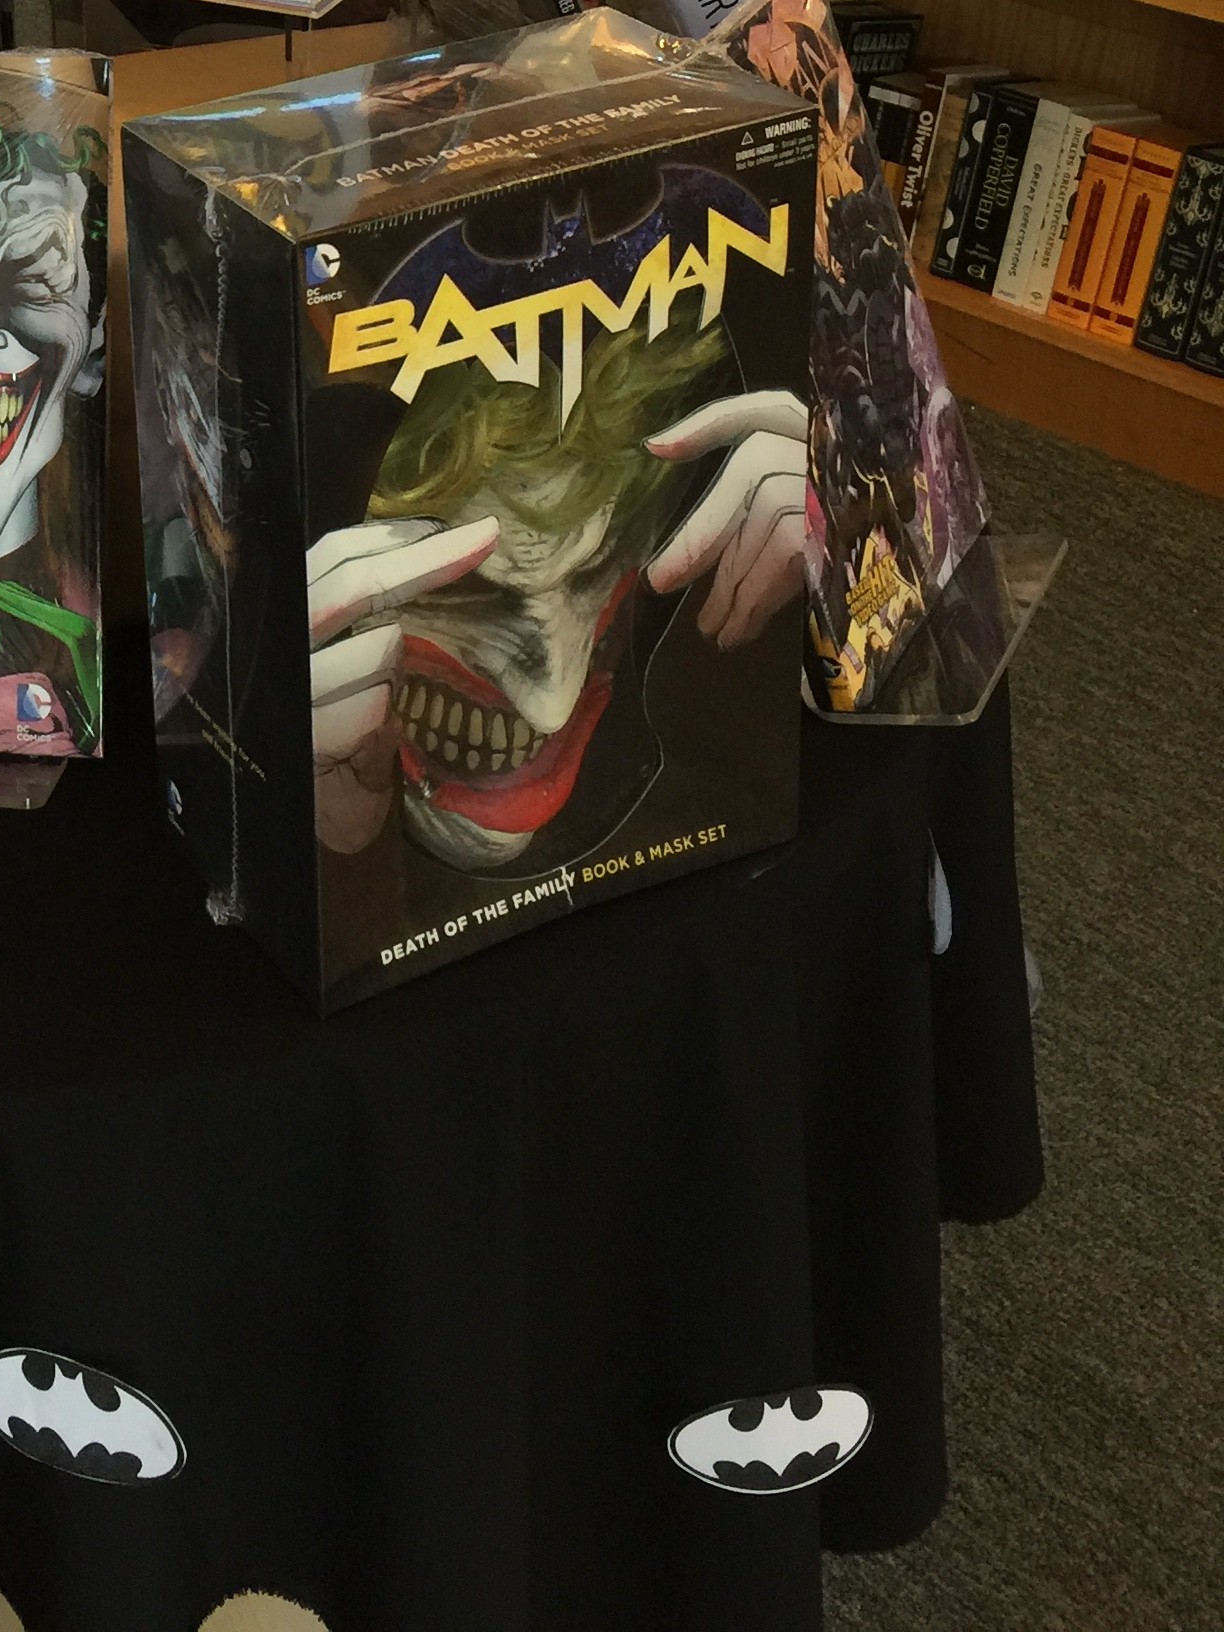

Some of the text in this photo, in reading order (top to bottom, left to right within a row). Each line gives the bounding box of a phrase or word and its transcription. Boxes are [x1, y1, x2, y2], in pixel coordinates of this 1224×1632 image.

[852, 32, 911, 51] CHARLES
[335, 151, 435, 189] BATMAN
[437, 129, 516, 163] DEATH
[519, 123, 558, 144] OF
[557, 110, 605, 138] THE
[764, 116, 812, 139] WARNING:
[899, 110, 934, 208] Oliver Twist
[975, 121, 1013, 230] COPPERFIELD
[996, 155, 1019, 208] DAVID
[1007, 162, 1043, 277] GREAT EXPECTATIONS
[306, 290, 345, 306] COMICS
[328, 203, 789, 433] BATMAN
[16, 732, 52, 742] COMICS
[582, 824, 728, 884] BOOK & MASK SET
[379, 871, 577, 967] DEATH OF THE FAMILY
